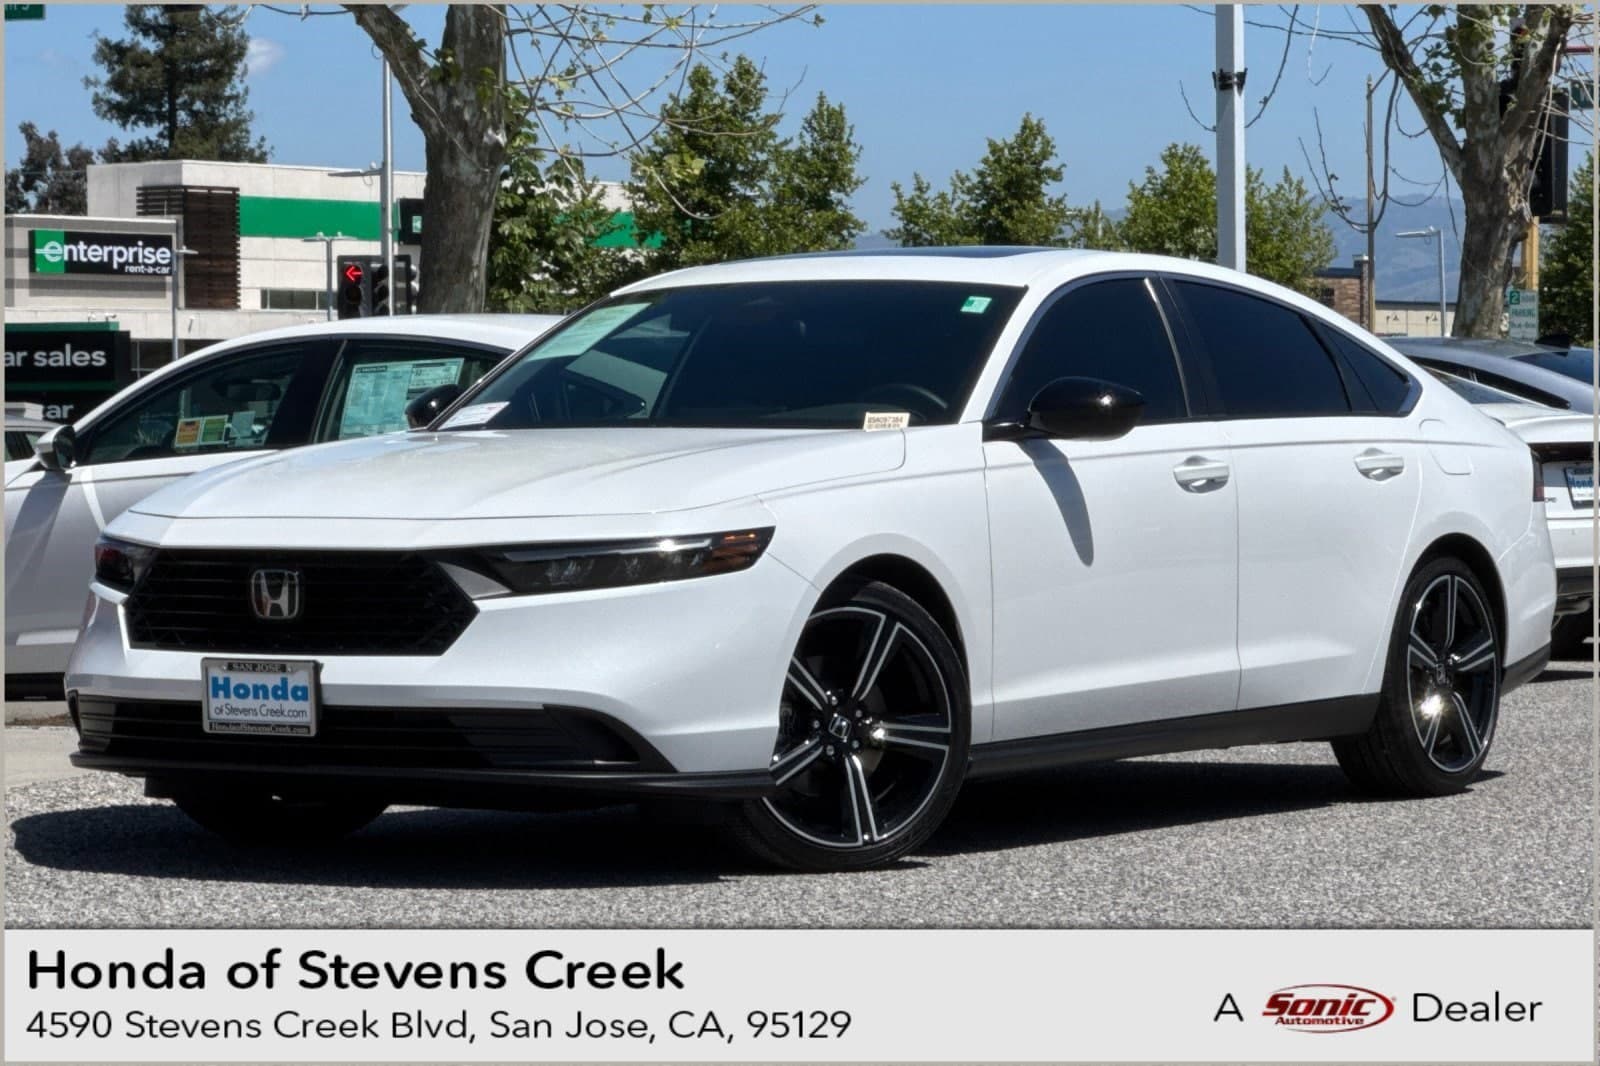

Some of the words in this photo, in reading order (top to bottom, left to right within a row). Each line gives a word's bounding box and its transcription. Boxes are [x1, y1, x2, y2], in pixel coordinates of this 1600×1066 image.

[37, 240, 171, 269] enterprise
[125, 264, 171, 274] rent-a-car
[1510, 292, 1520, 304] 2
[33, 343, 107, 367] sales
[46, 404, 74, 419] ar
[232, 663, 254, 672] SAN
[255, 663, 282, 673] JOSE
[211, 676, 309, 702] Honda
